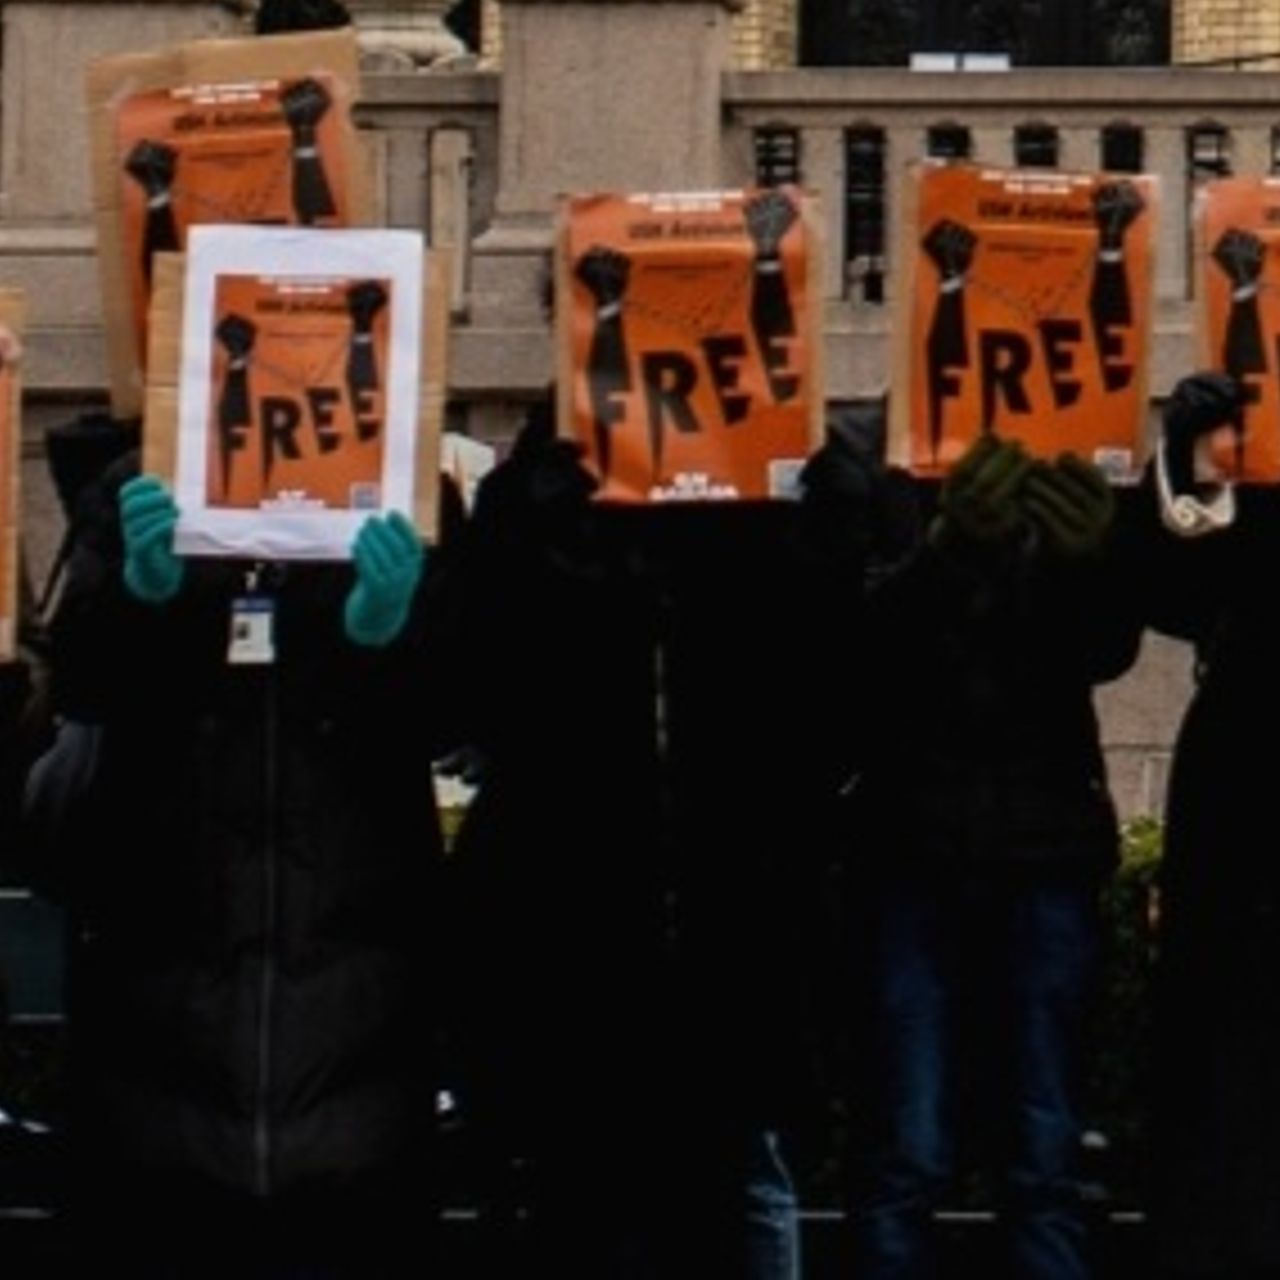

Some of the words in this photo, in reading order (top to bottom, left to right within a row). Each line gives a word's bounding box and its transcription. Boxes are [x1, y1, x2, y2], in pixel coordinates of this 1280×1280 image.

[218, 382, 382, 500] FREE
[587, 315, 801, 486] FREE
[927, 308, 1133, 464] FREE
